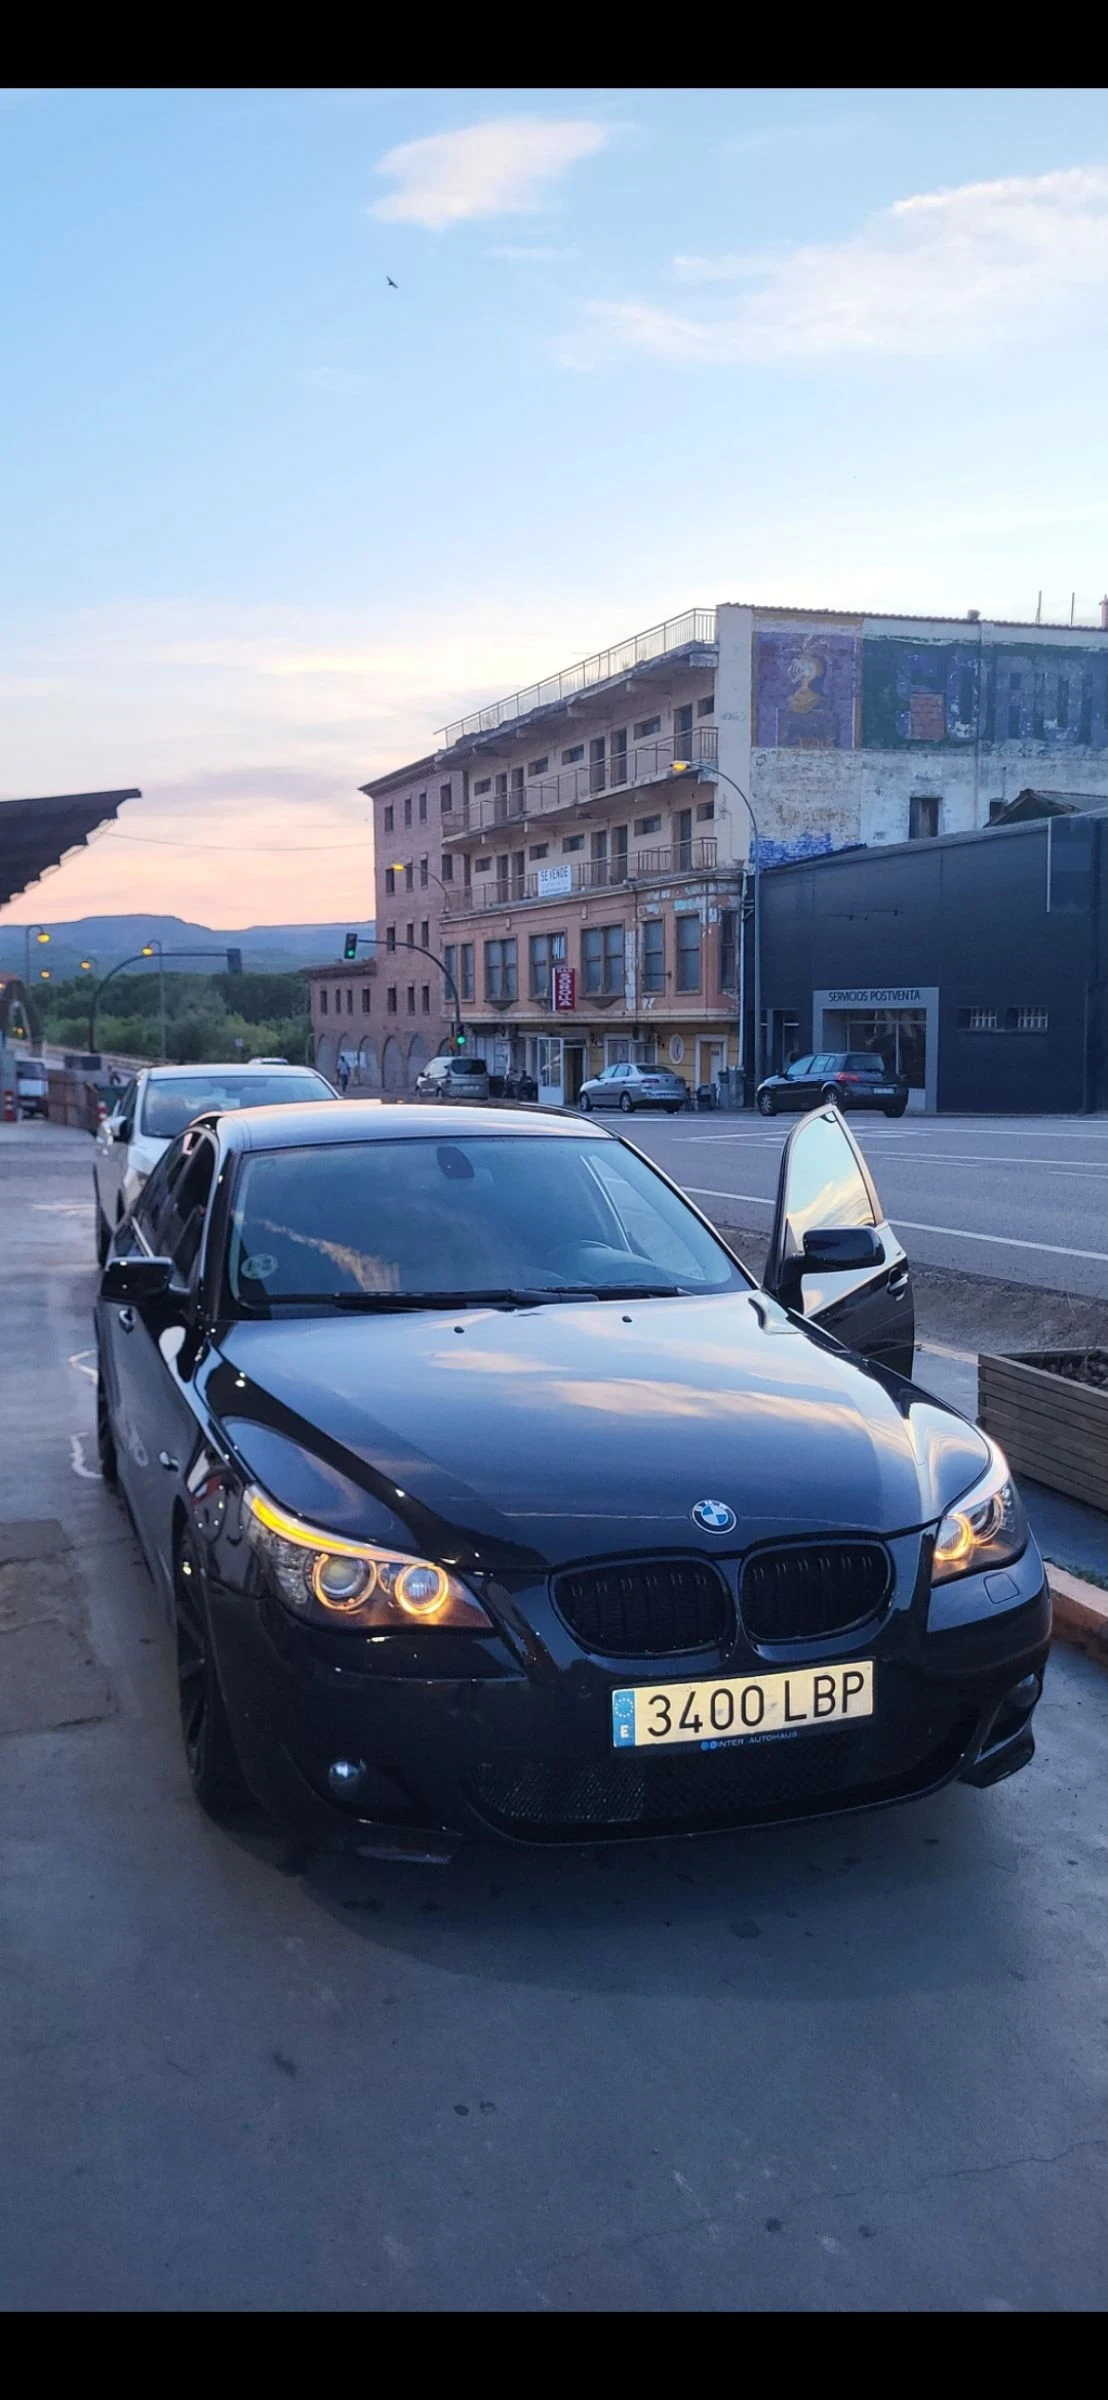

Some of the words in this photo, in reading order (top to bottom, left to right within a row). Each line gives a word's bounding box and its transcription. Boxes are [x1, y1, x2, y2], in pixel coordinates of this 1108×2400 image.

[540, 869, 548, 882] SE
[549, 866, 568, 880] VENDE
[828, 990, 868, 1002] SERVICIOS
[870, 989, 920, 1001] POSTVENTA
[647, 1685, 764, 1737] 3400
[784, 1671, 864, 1722] LBP
[620, 1724, 629, 1738] E
[748, 1731, 797, 1744] AUTOHAUS
